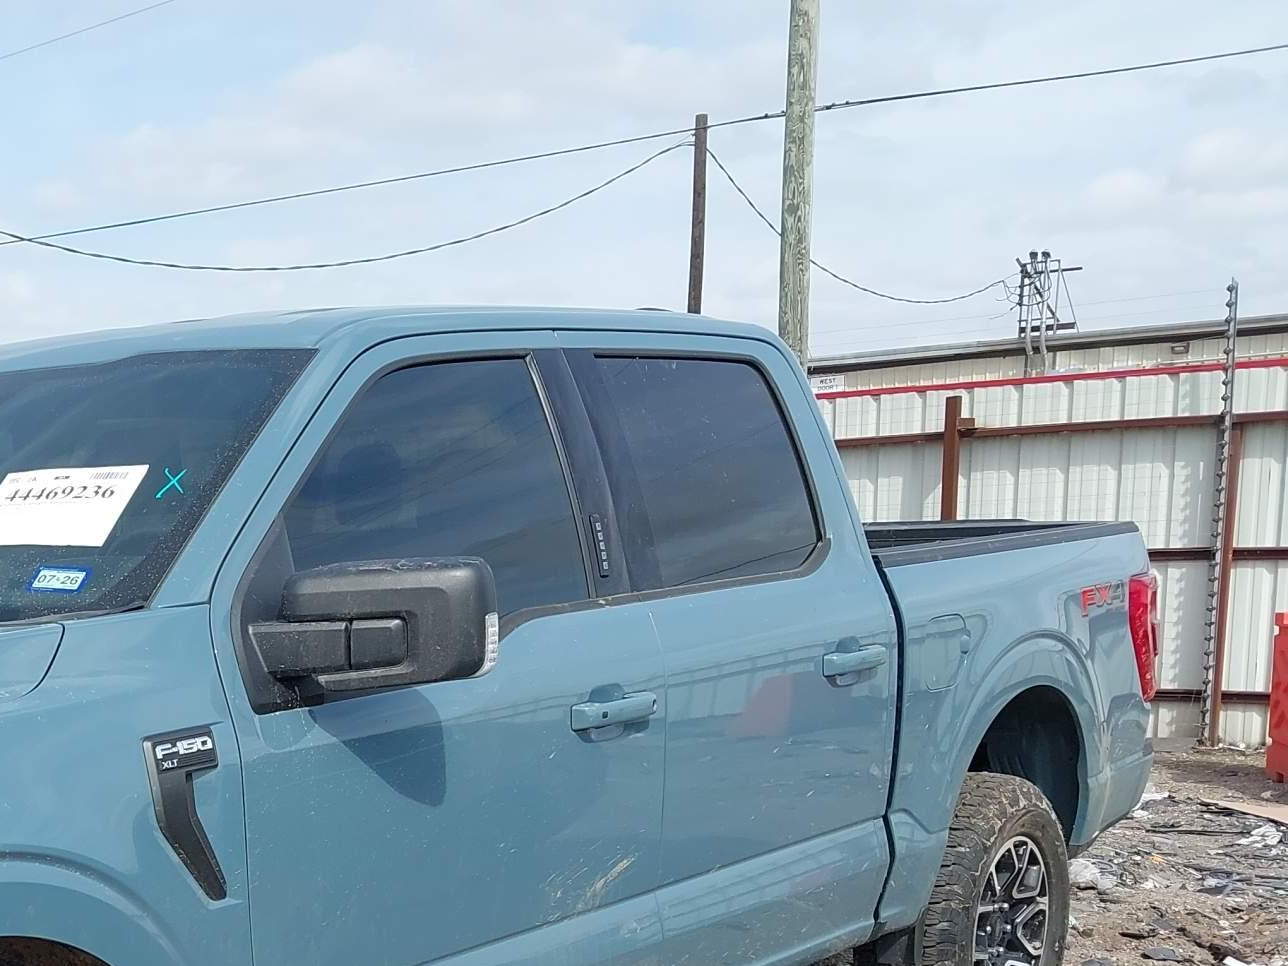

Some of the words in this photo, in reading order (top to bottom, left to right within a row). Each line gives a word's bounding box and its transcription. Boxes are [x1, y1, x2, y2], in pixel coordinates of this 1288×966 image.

[4, 484, 117, 502] 44469236
[1081, 582, 1125, 618] FX4
[155, 735, 213, 759] F-150
[161, 758, 178, 769] XLT
